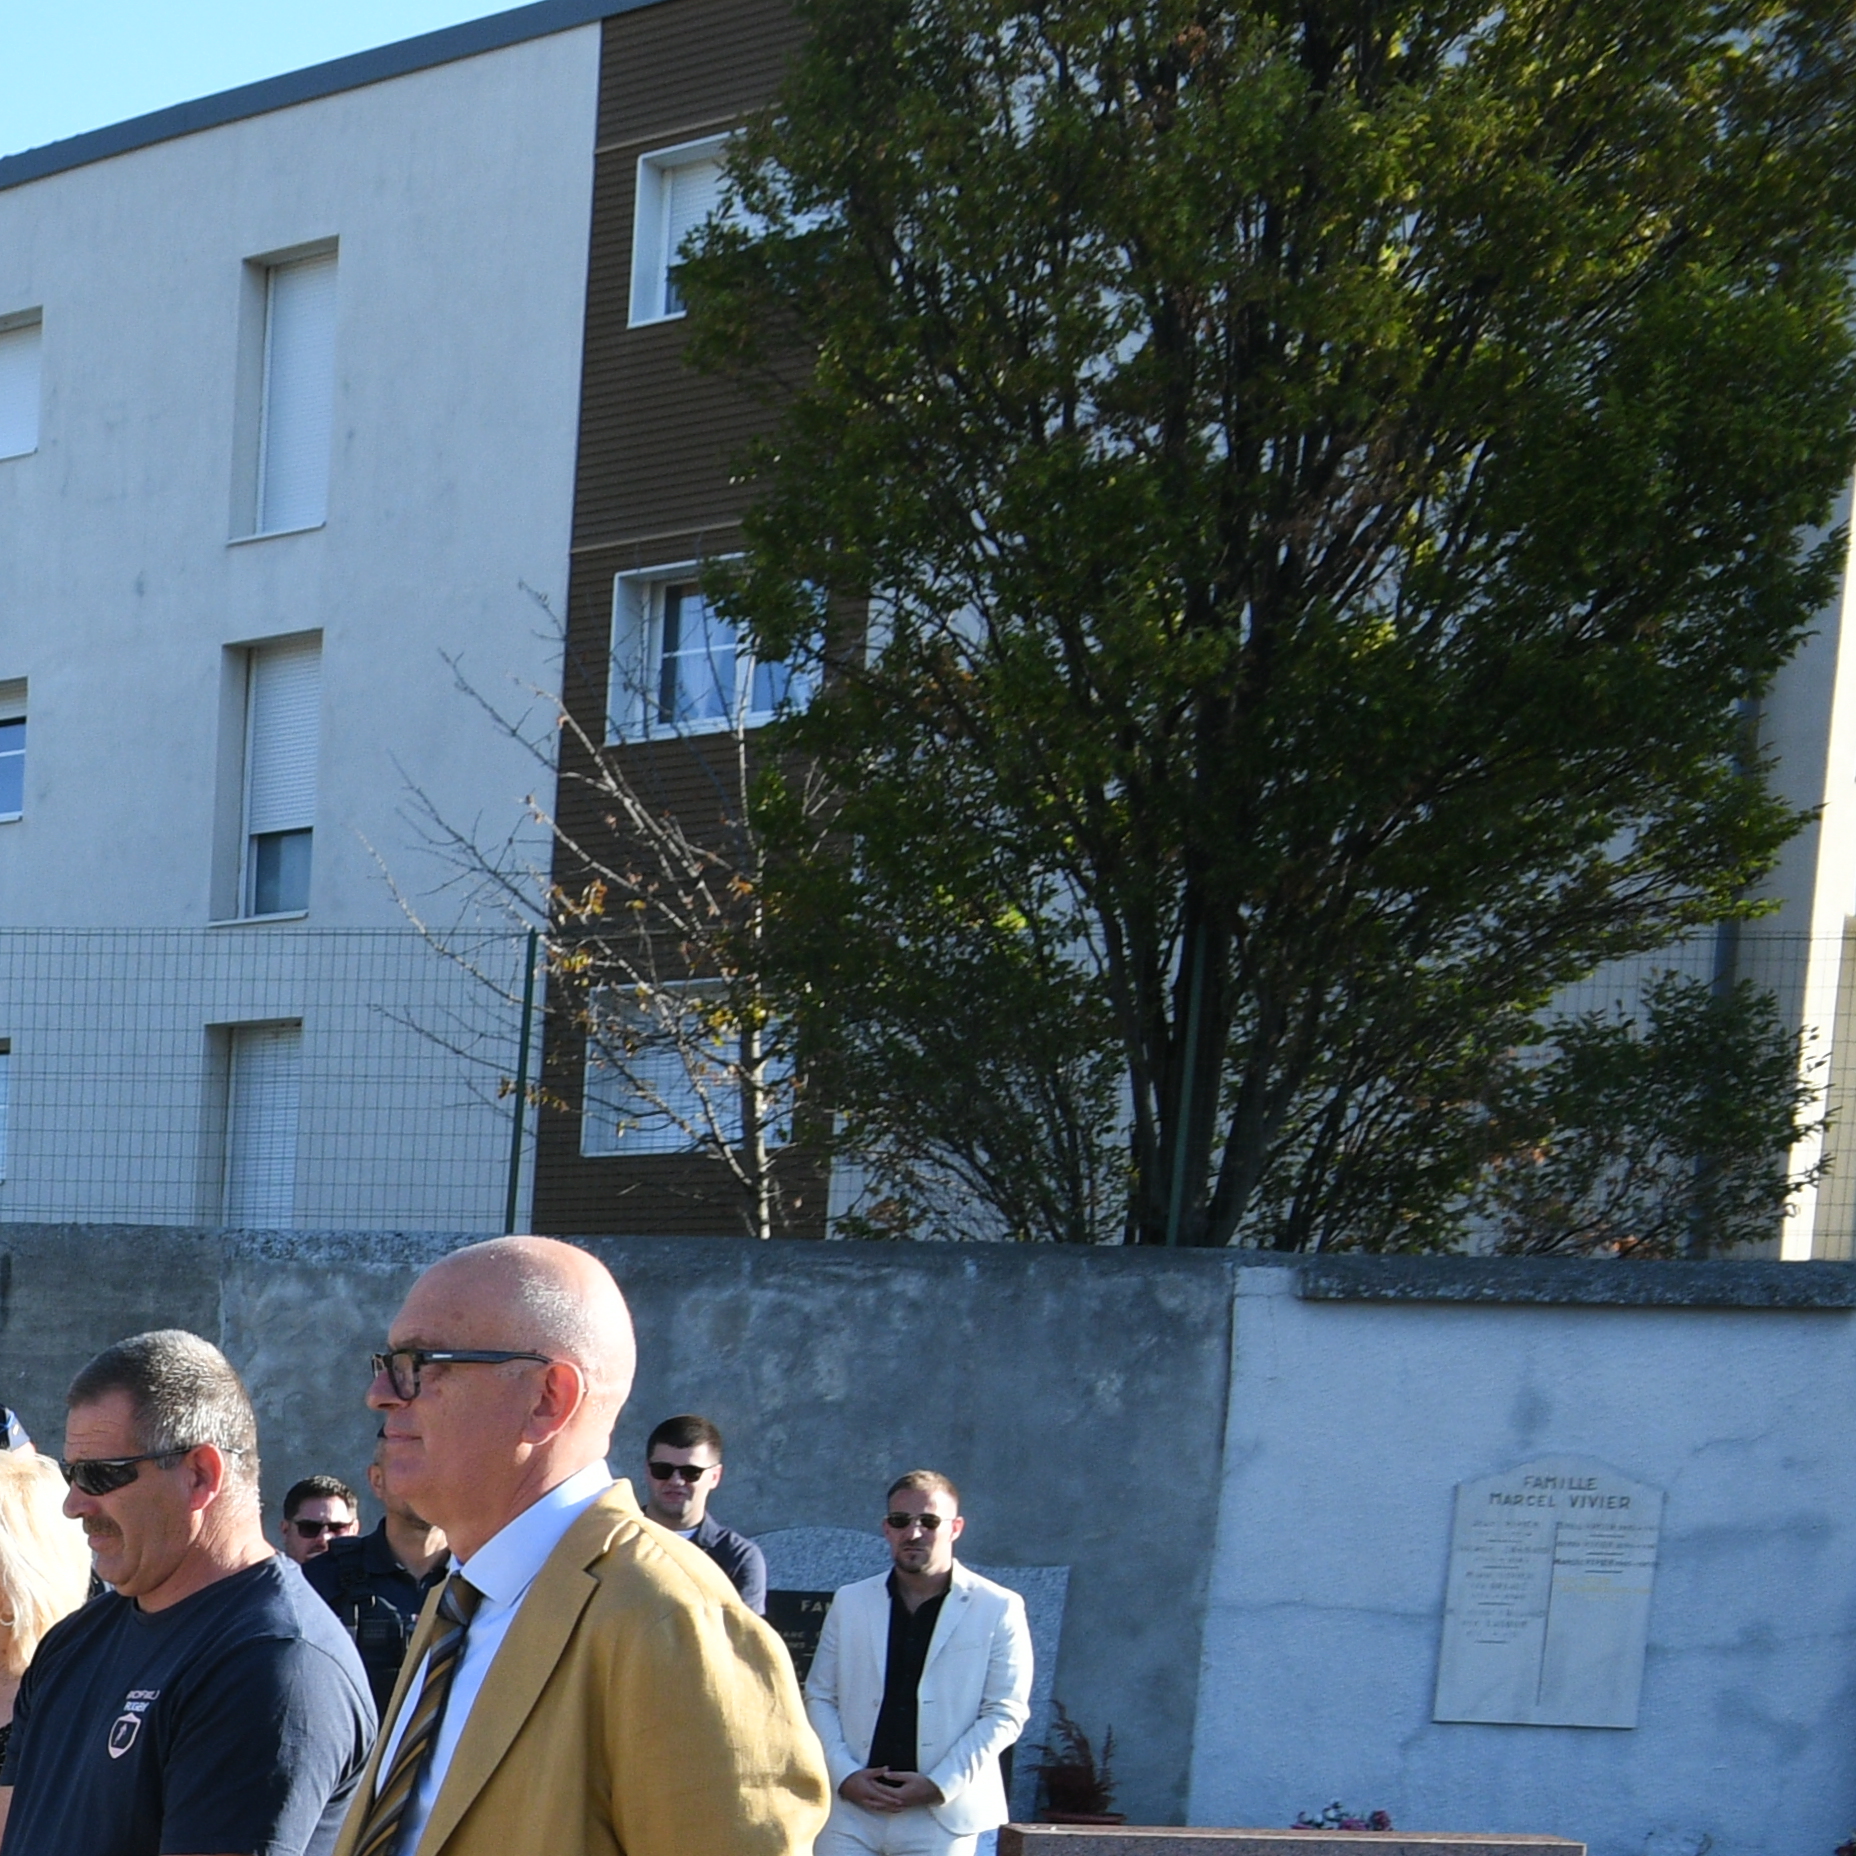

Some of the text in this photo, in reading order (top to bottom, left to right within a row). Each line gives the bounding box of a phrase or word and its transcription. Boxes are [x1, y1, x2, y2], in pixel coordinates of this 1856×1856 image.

[1524, 1476, 1598, 1491] FAMILLE
[1490, 1492, 1631, 1509] MARCEL VIVIER
